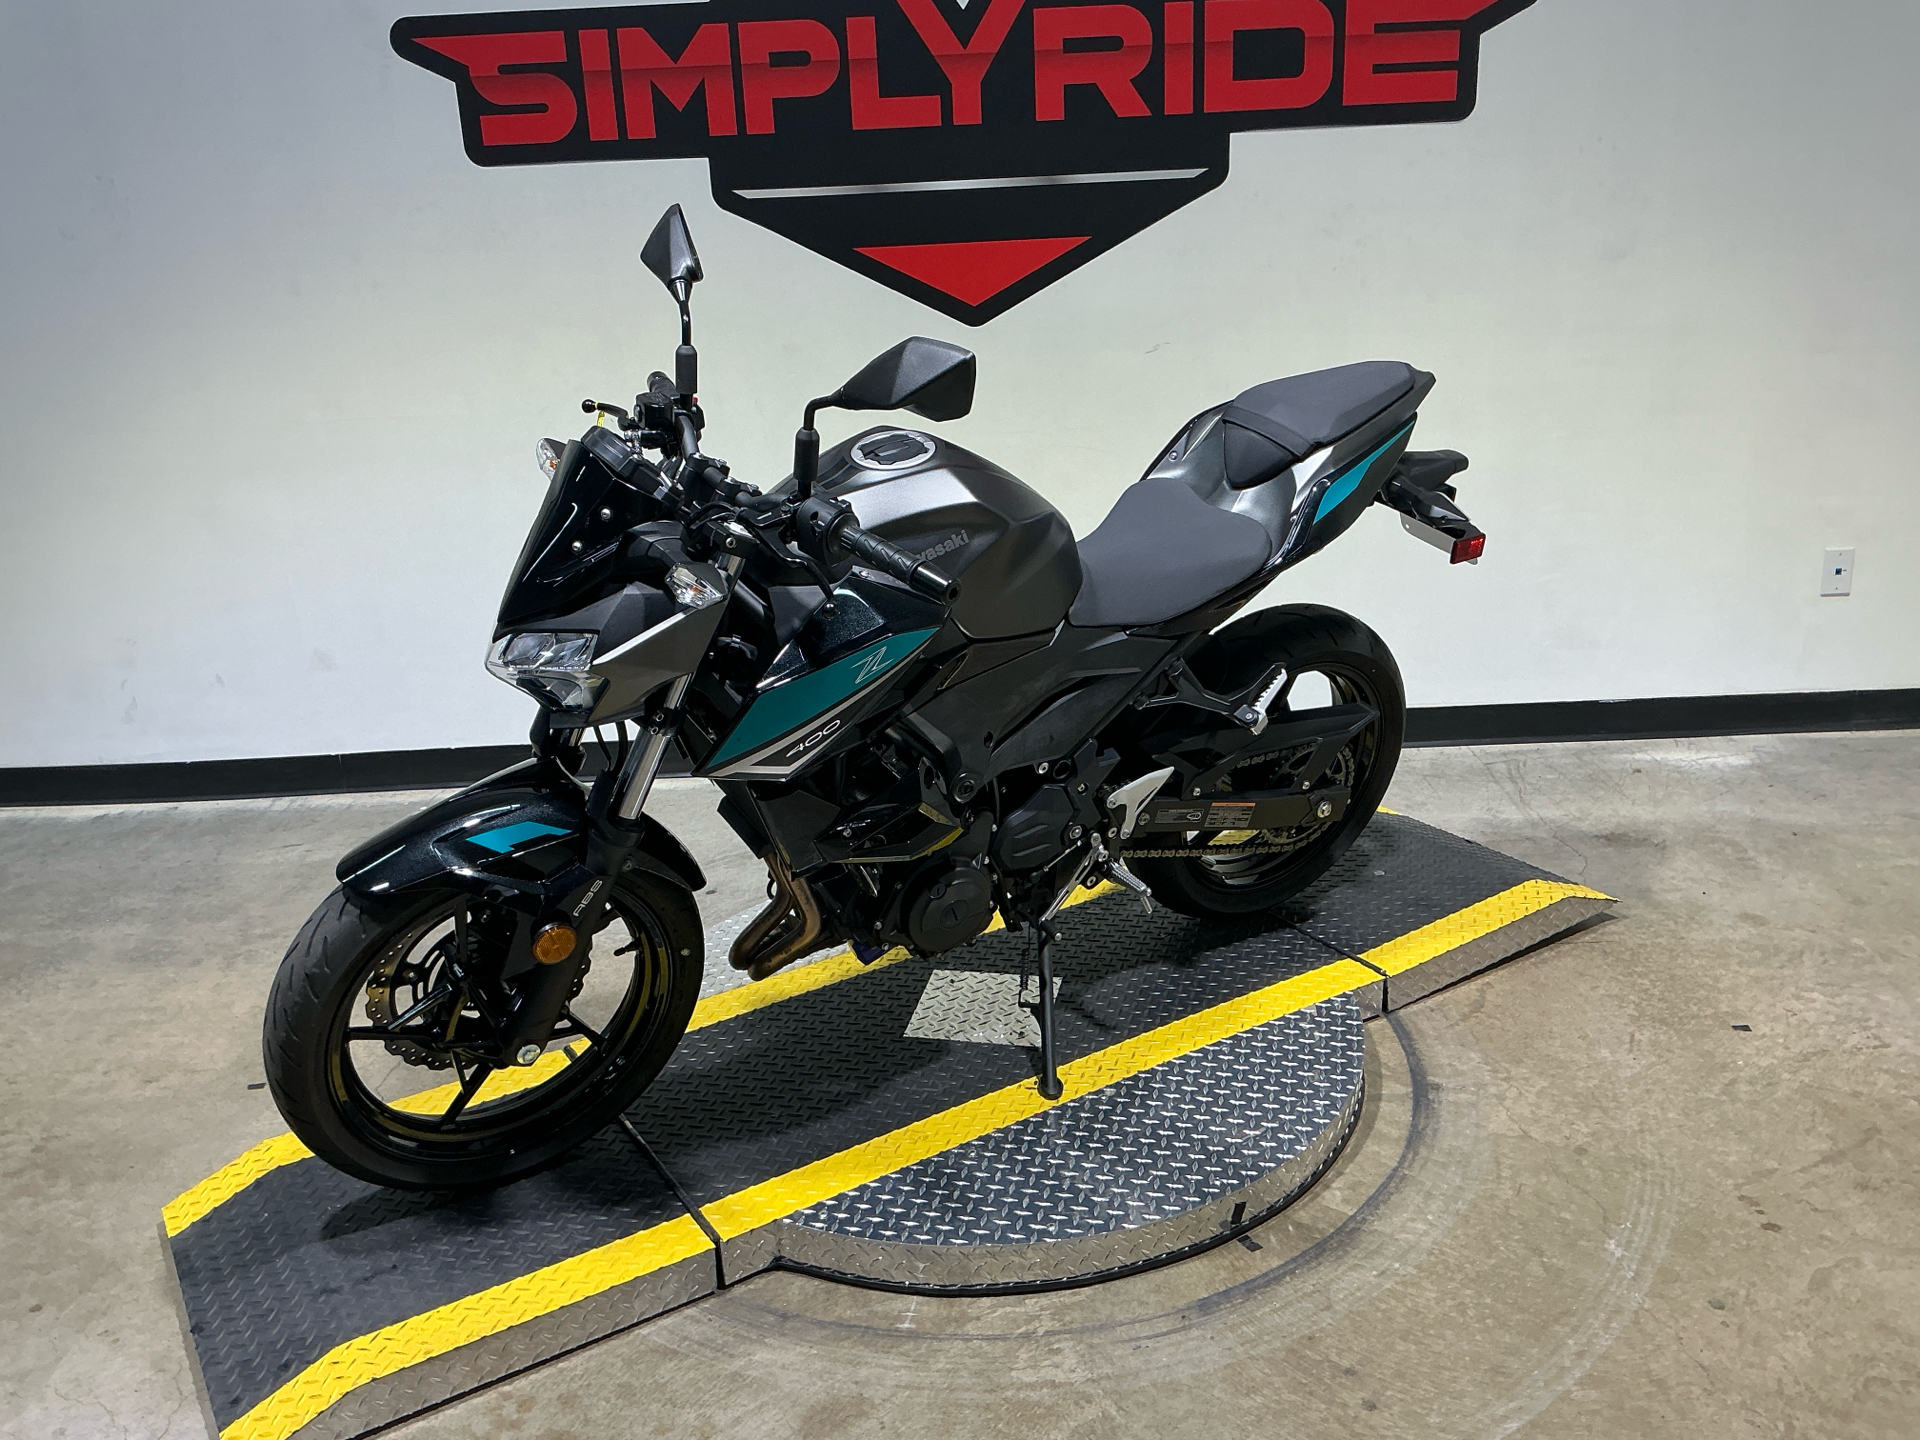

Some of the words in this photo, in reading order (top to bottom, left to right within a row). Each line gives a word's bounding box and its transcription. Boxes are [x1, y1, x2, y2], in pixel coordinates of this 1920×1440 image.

[915, 529, 970, 562] asaki
[850, 645, 895, 685] Z
[785, 719, 841, 758] 400
[572, 879, 603, 917] ABS
